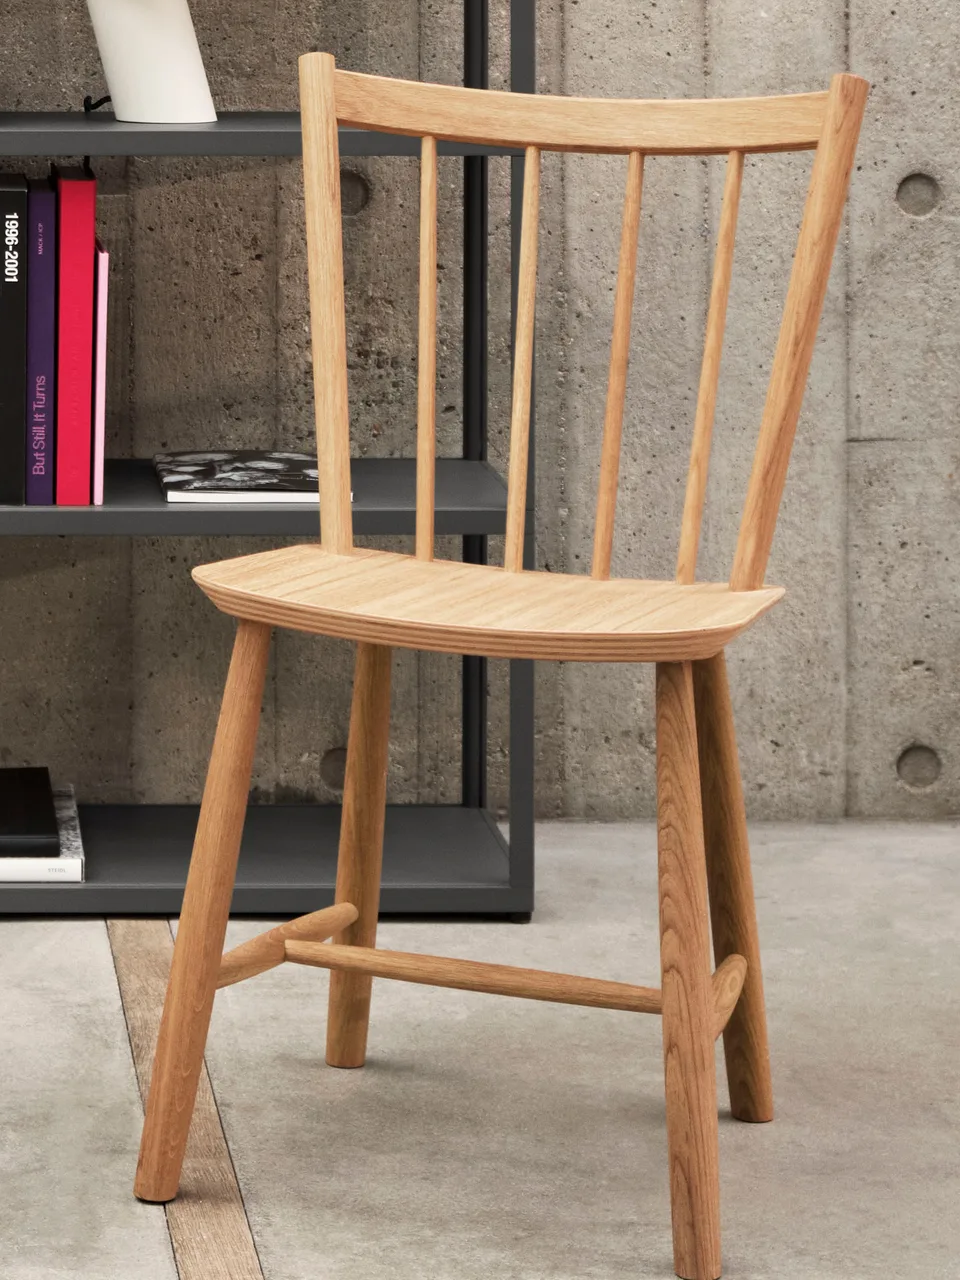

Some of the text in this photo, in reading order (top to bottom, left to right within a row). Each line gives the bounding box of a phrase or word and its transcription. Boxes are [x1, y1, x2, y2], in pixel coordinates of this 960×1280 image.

[5, 212, 19, 283] 1996-2001
[32, 375, 46, 475] But Still, It Turns
